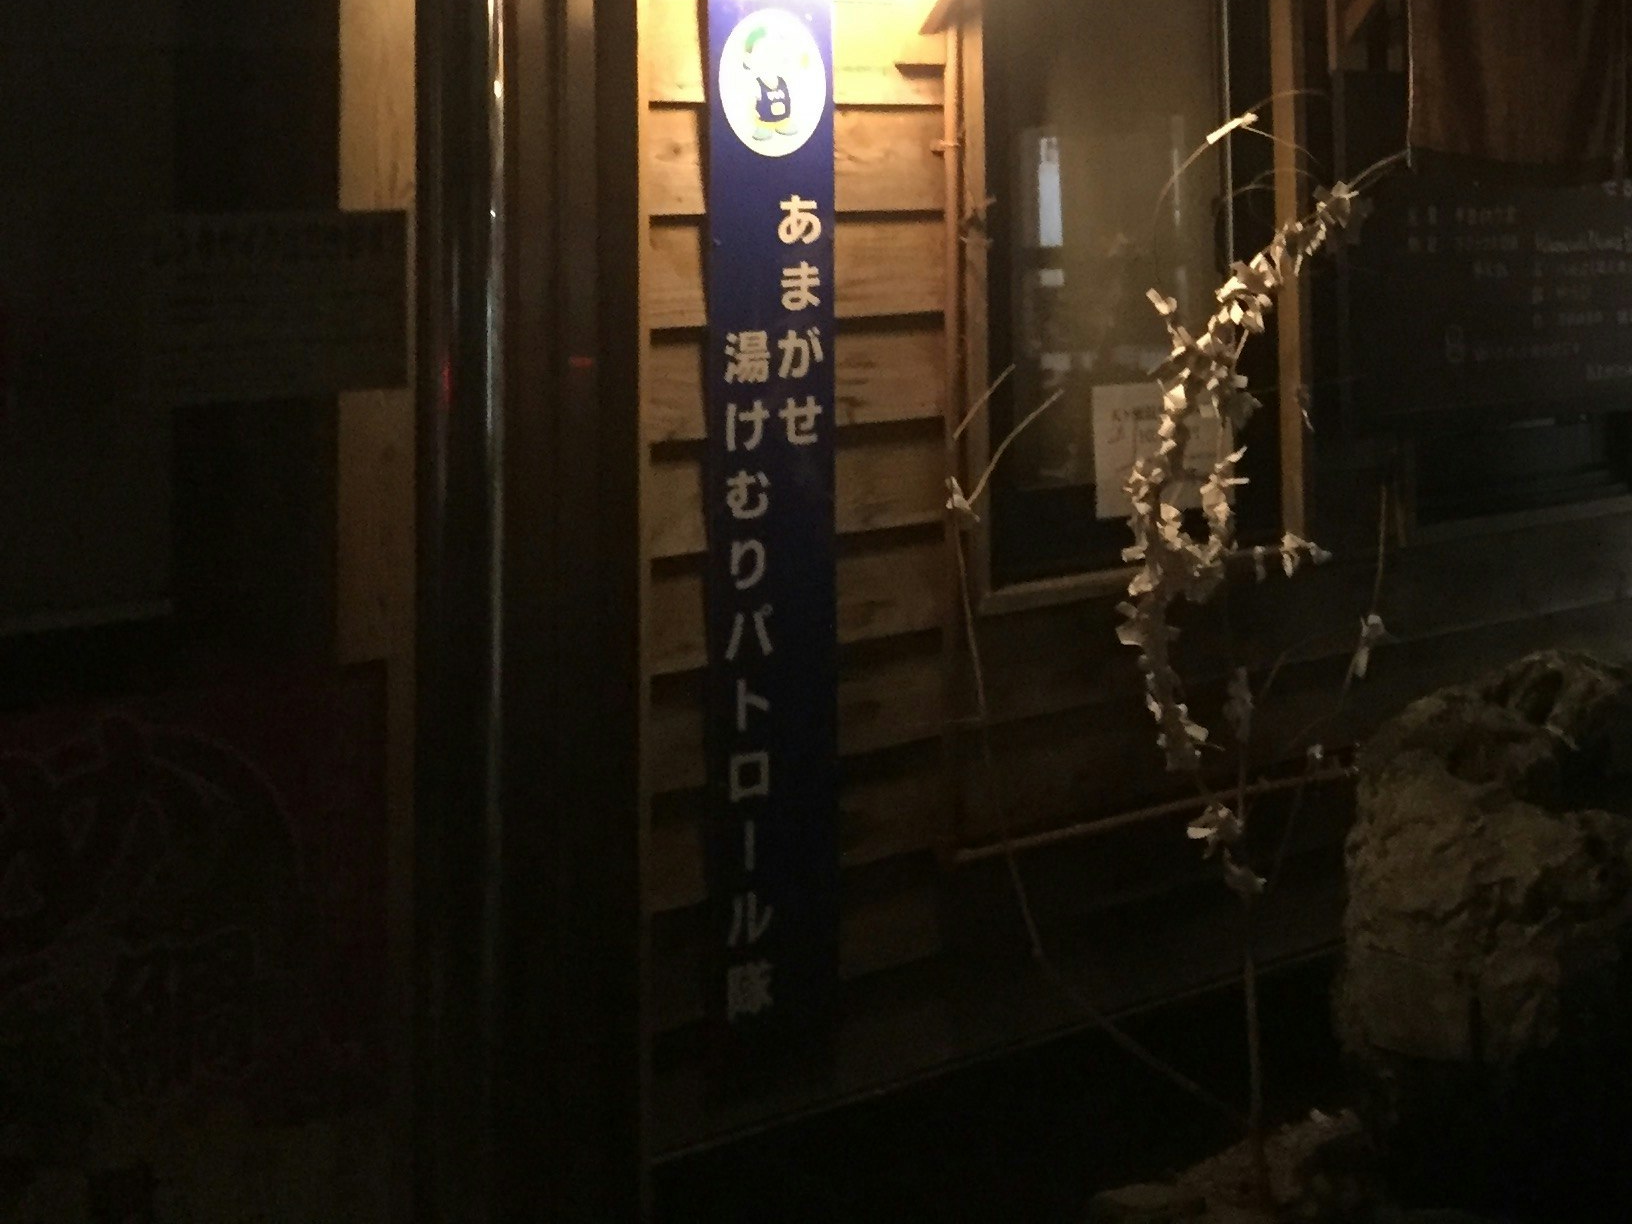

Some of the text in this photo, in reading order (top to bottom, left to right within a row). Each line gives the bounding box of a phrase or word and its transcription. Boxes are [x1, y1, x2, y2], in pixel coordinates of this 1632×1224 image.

[776, 193, 825, 447] あまがせ
[724, 329, 775, 1024] 湯けむりパトロール隊
